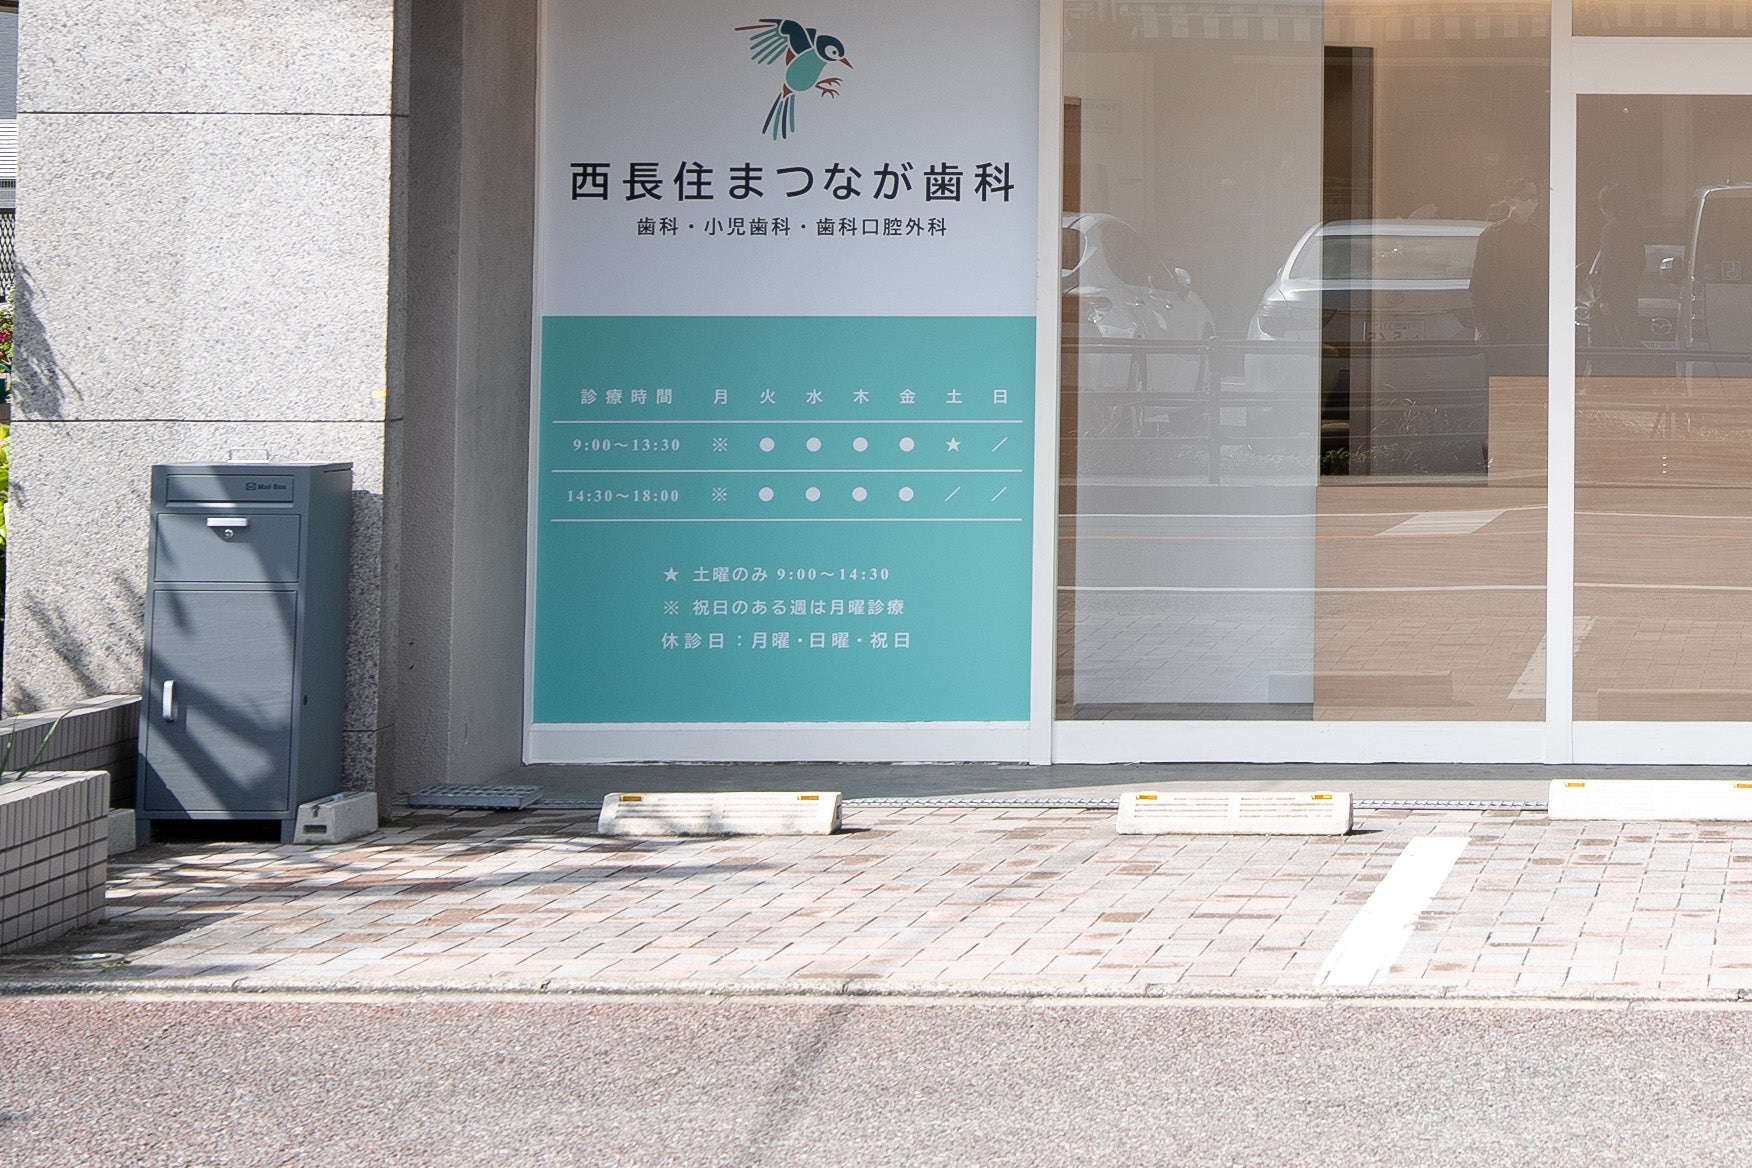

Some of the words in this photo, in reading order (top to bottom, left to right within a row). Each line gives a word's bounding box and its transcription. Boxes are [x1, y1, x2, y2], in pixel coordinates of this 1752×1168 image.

[569, 160, 1016, 202] 西長住まつなが歯科
[636, 216, 948, 237] 歯科・小児歯科・歯科口腔外科
[580, 388, 673, 405] 診療時間
[713, 388, 728, 405] 月
[759, 388, 776, 405] 火
[806, 388, 823, 405] 水
[852, 388, 870, 405] 木
[899, 388, 916, 405] 金
[945, 388, 963, 404] 土
[993, 389, 1008, 405] 日
[692, 566, 768, 583] 土曜のみ
